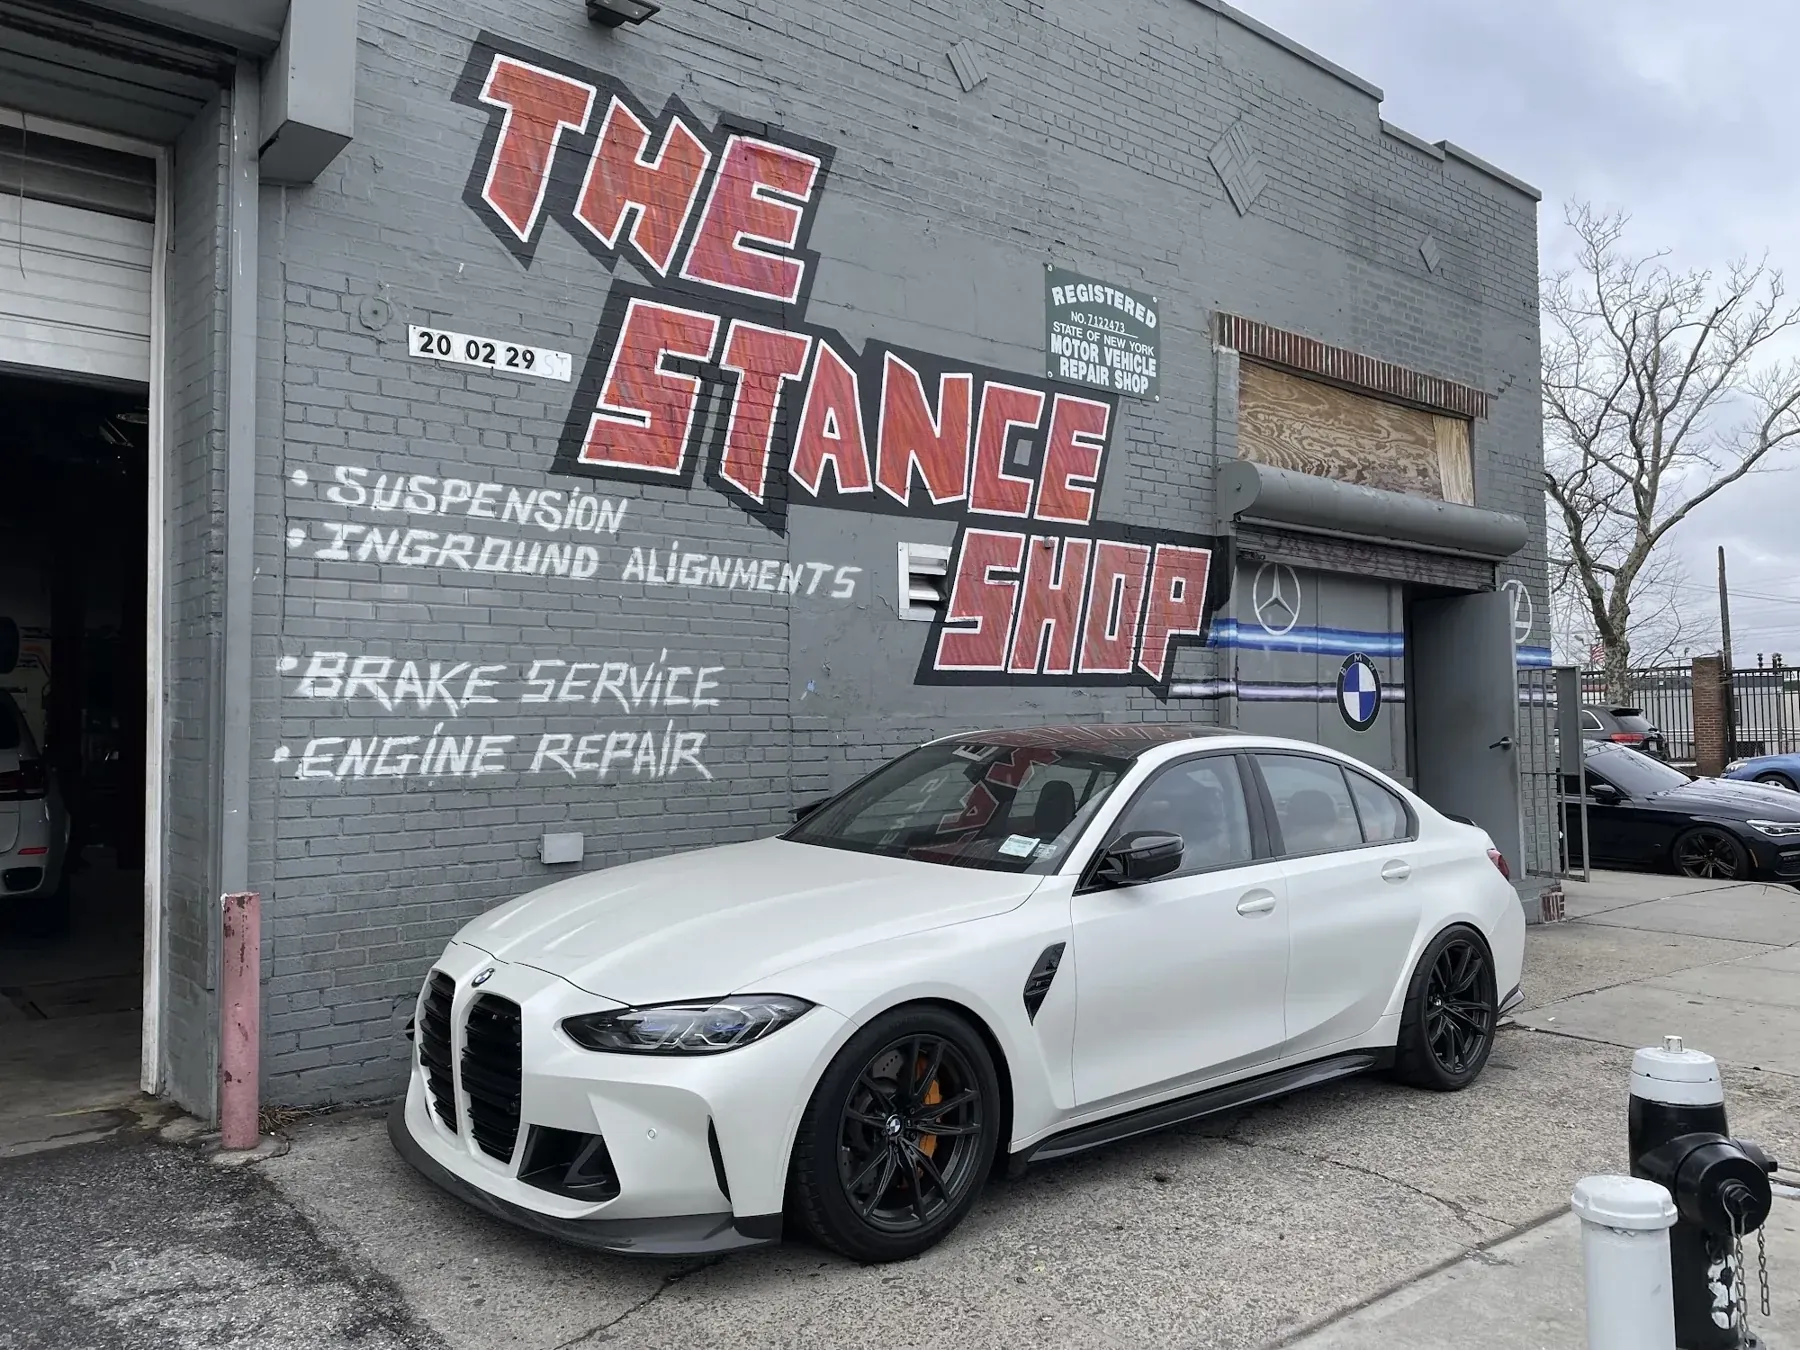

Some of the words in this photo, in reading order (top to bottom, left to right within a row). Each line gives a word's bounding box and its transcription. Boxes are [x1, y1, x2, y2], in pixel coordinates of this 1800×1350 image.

[478, 53, 822, 304] THE
[1051, 283, 1157, 328] REGISTERED
[419, 331, 451, 356] 20
[465, 339, 496, 364] 02
[506, 346, 535, 370] 29
[1051, 333, 1099, 363] MOTOR
[1104, 347, 1157, 377] VEHICLE
[1053, 321, 1083, 338] STATE
[1086, 330, 1101, 342] OF
[1103, 334, 1126, 349] NEW
[1129, 341, 1155, 357] YORK
[1060, 356, 1110, 387] REPAIR
[1114, 369, 1149, 394] SHOP
[578, 297, 1110, 525] STANCE
[314, 522, 599, 579] INGROUND
[933, 528, 1212, 682] SHOP
[296, 651, 507, 716] BRAKE
[1340, 653, 1375, 676] BMW
